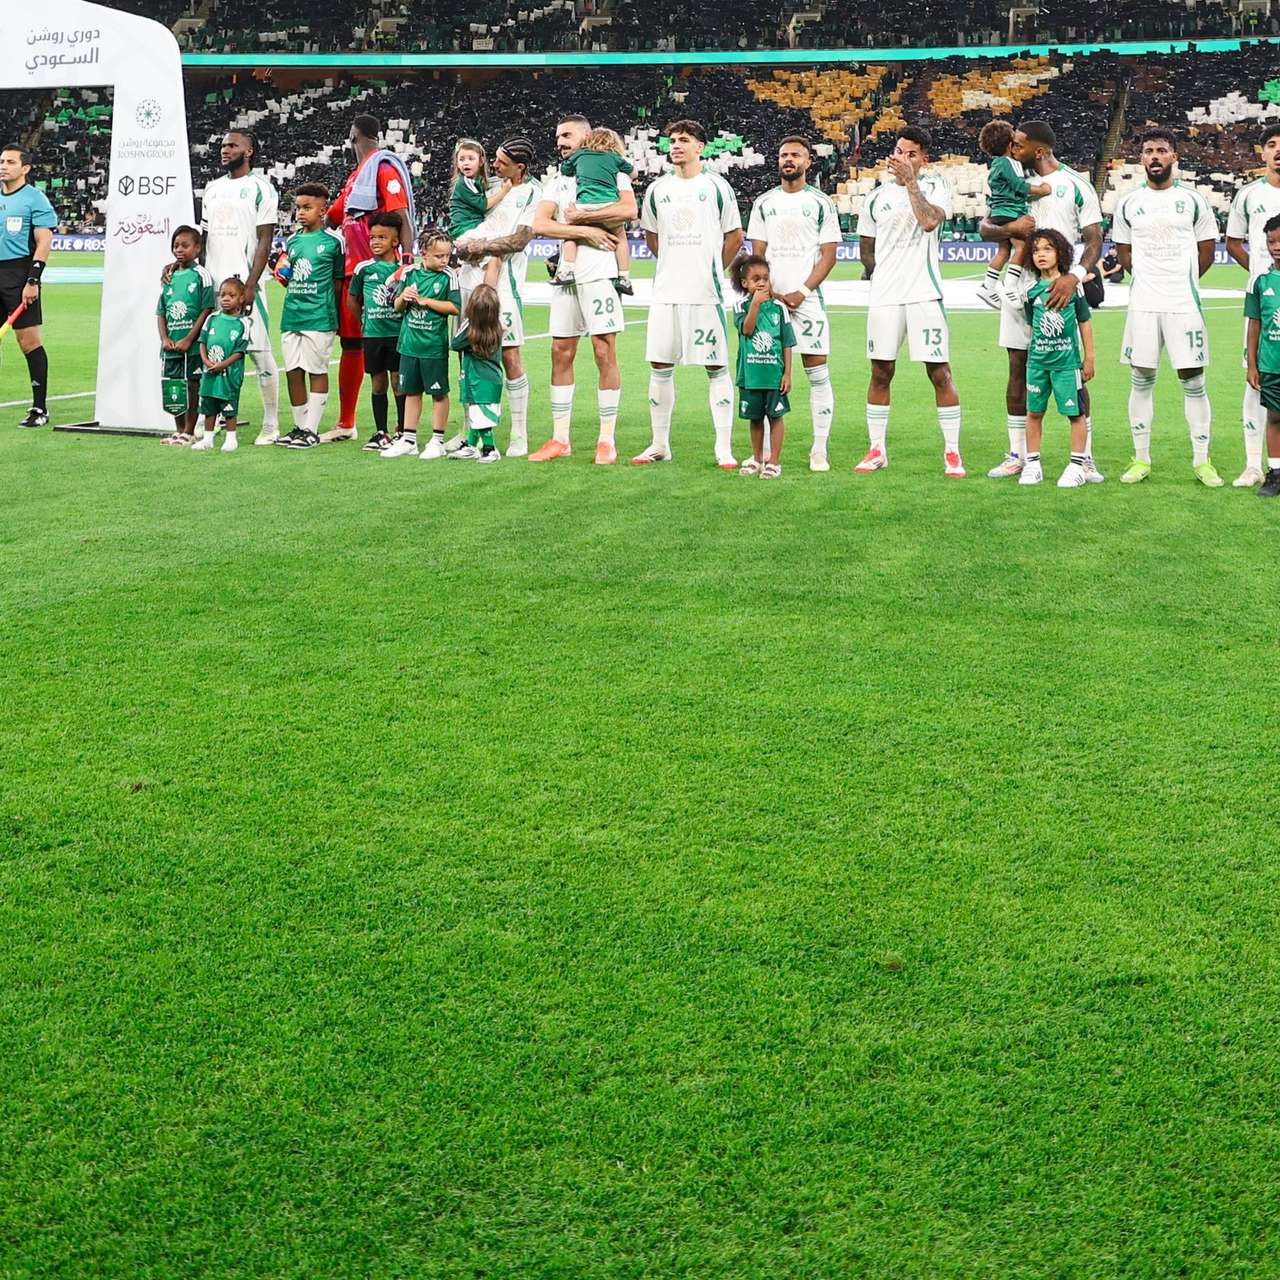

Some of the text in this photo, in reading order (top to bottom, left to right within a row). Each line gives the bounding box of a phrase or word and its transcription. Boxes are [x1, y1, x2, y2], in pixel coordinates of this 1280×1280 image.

[26, 27, 100, 47] دوري روشن
[24, 47, 100, 75] السعودي
[138, 175, 177, 196] BSF
[836, 246, 861, 260] GU
[947, 247, 993, 261] SAUDI
[592, 297, 616, 316] 28
[694, 328, 718, 346] 24
[802, 319, 825, 337] 27
[922, 328, 943, 346] 13
[1185, 330, 1204, 349] 15
